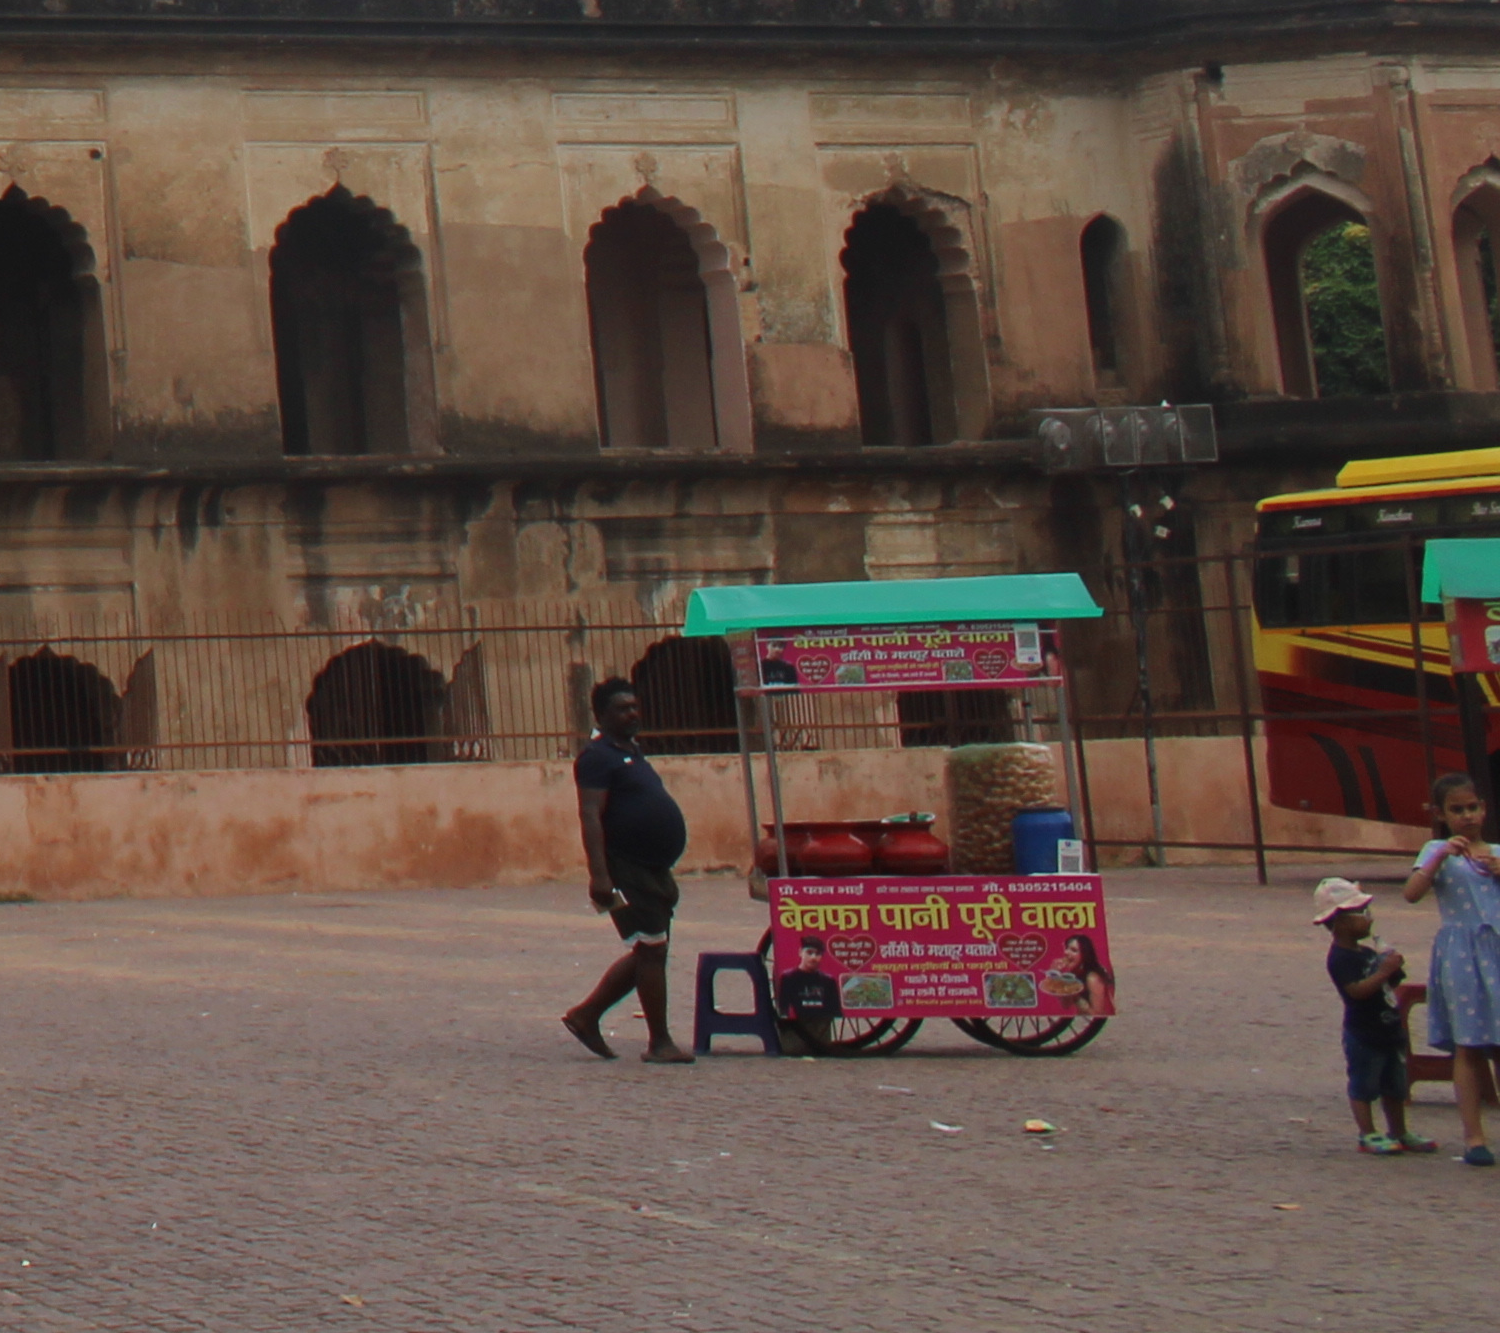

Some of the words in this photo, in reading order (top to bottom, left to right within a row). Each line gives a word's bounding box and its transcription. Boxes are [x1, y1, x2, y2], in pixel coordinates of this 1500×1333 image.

[793, 634, 855, 649] बेवफा
[862, 629, 909, 646] पानी
[916, 628, 952, 648] पूरी
[958, 632, 1009, 643] वाला
[873, 649, 888, 660] के
[1008, 882, 1092, 892] 8305215404
[778, 897, 870, 931] बेवफा
[877, 894, 950, 930] पानी
[957, 894, 1012, 940] पूरी
[1019, 902, 1096, 929] वाला
[911, 941, 925, 957] के
[927, 944, 963, 961] मशहूर
